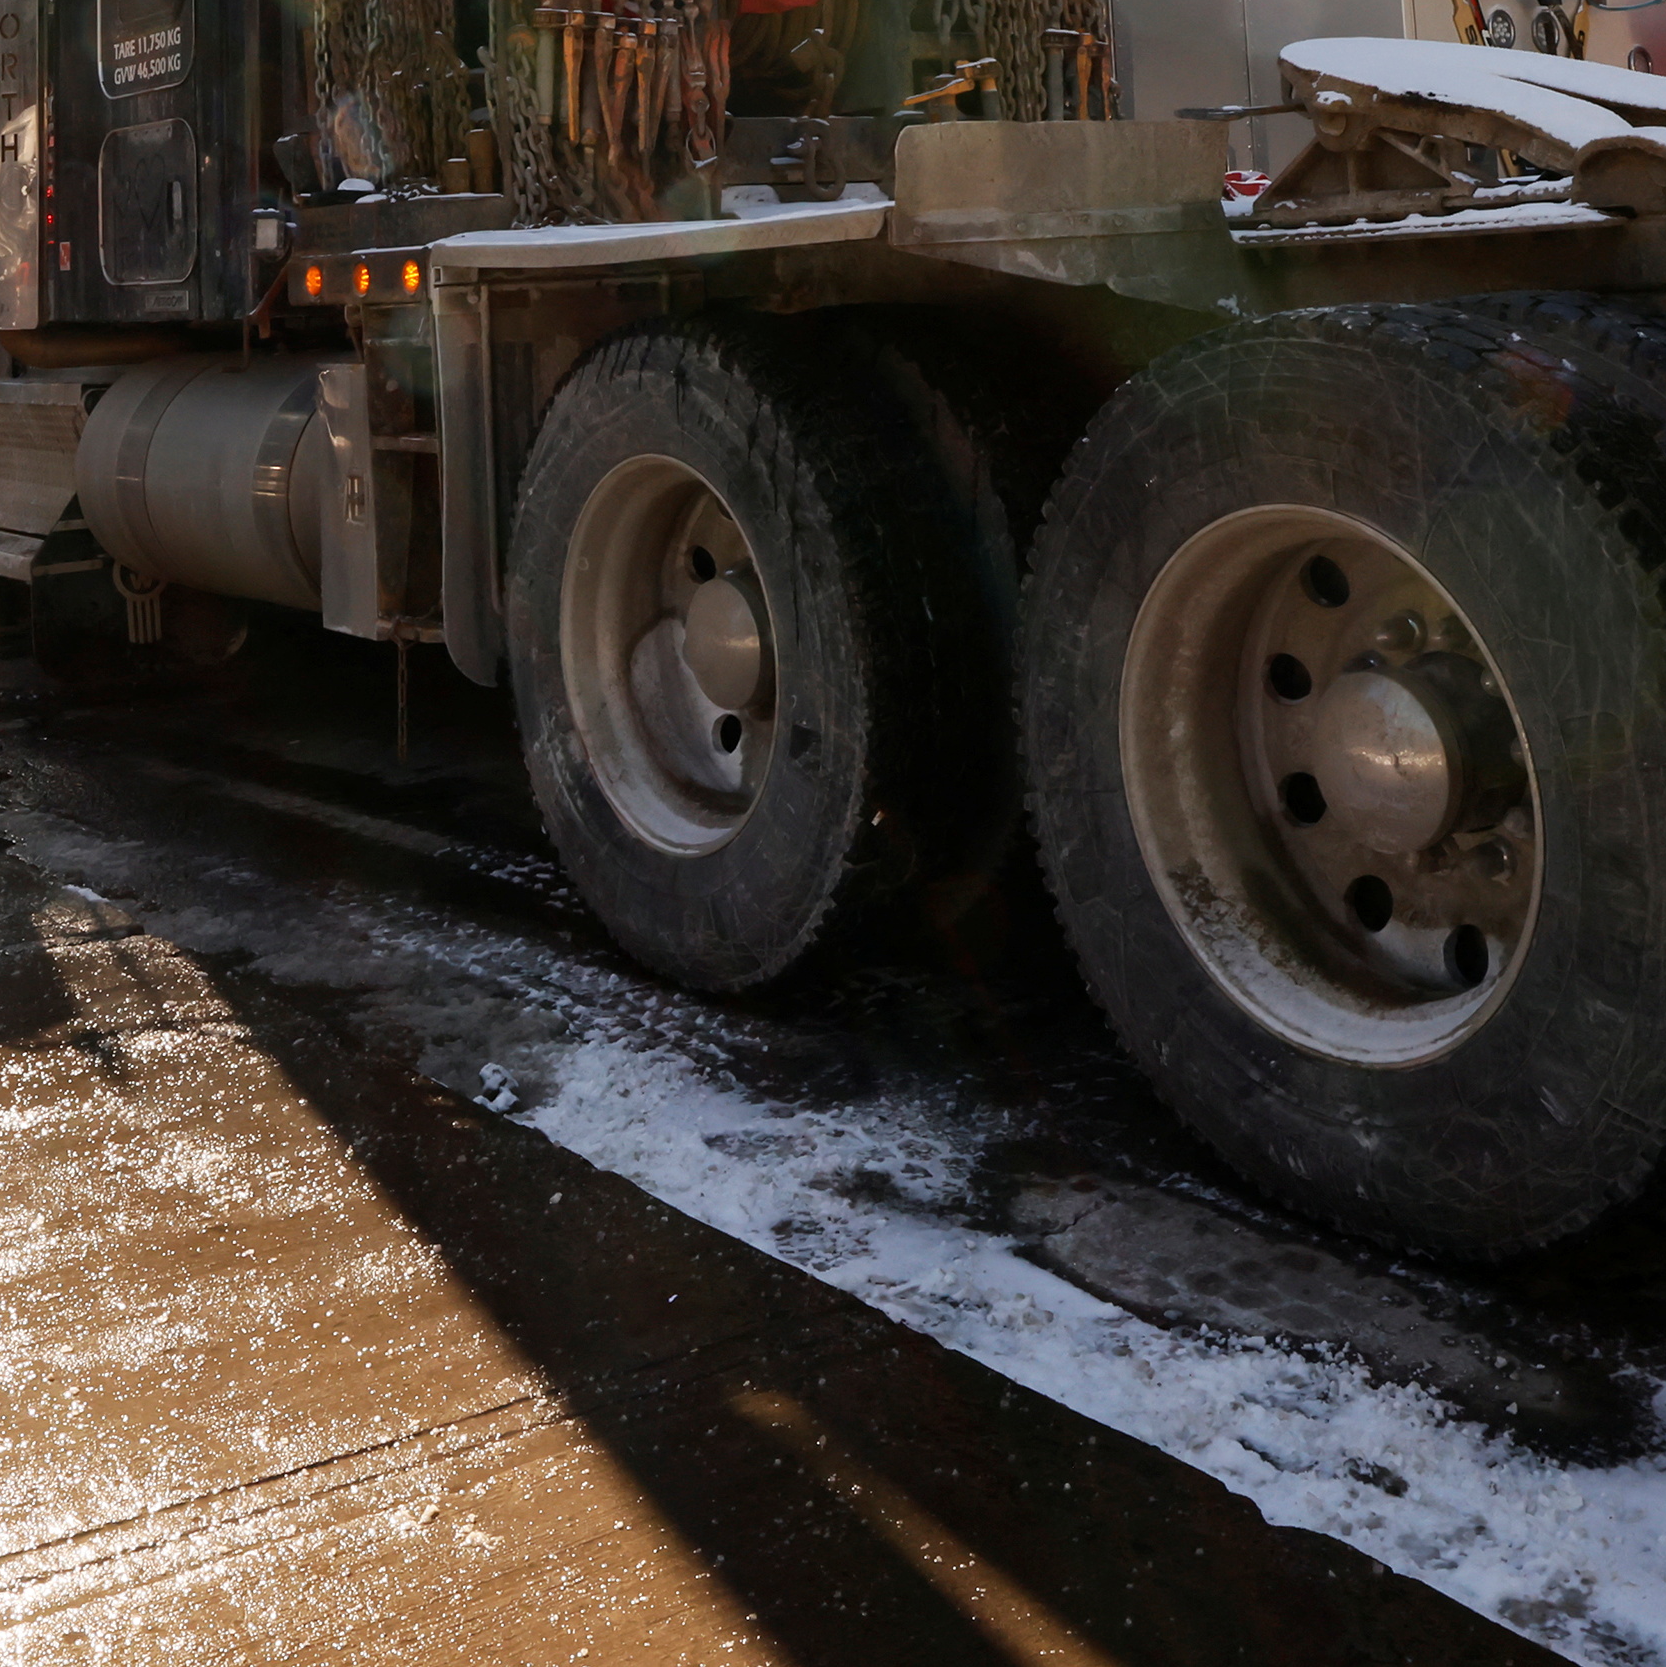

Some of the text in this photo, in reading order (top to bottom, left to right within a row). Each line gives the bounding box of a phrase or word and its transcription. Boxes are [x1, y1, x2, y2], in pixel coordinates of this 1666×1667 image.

[113, 26, 181, 60] TARE 11,750 KG
[114, 53, 181, 85] GVW 46,500 KG
